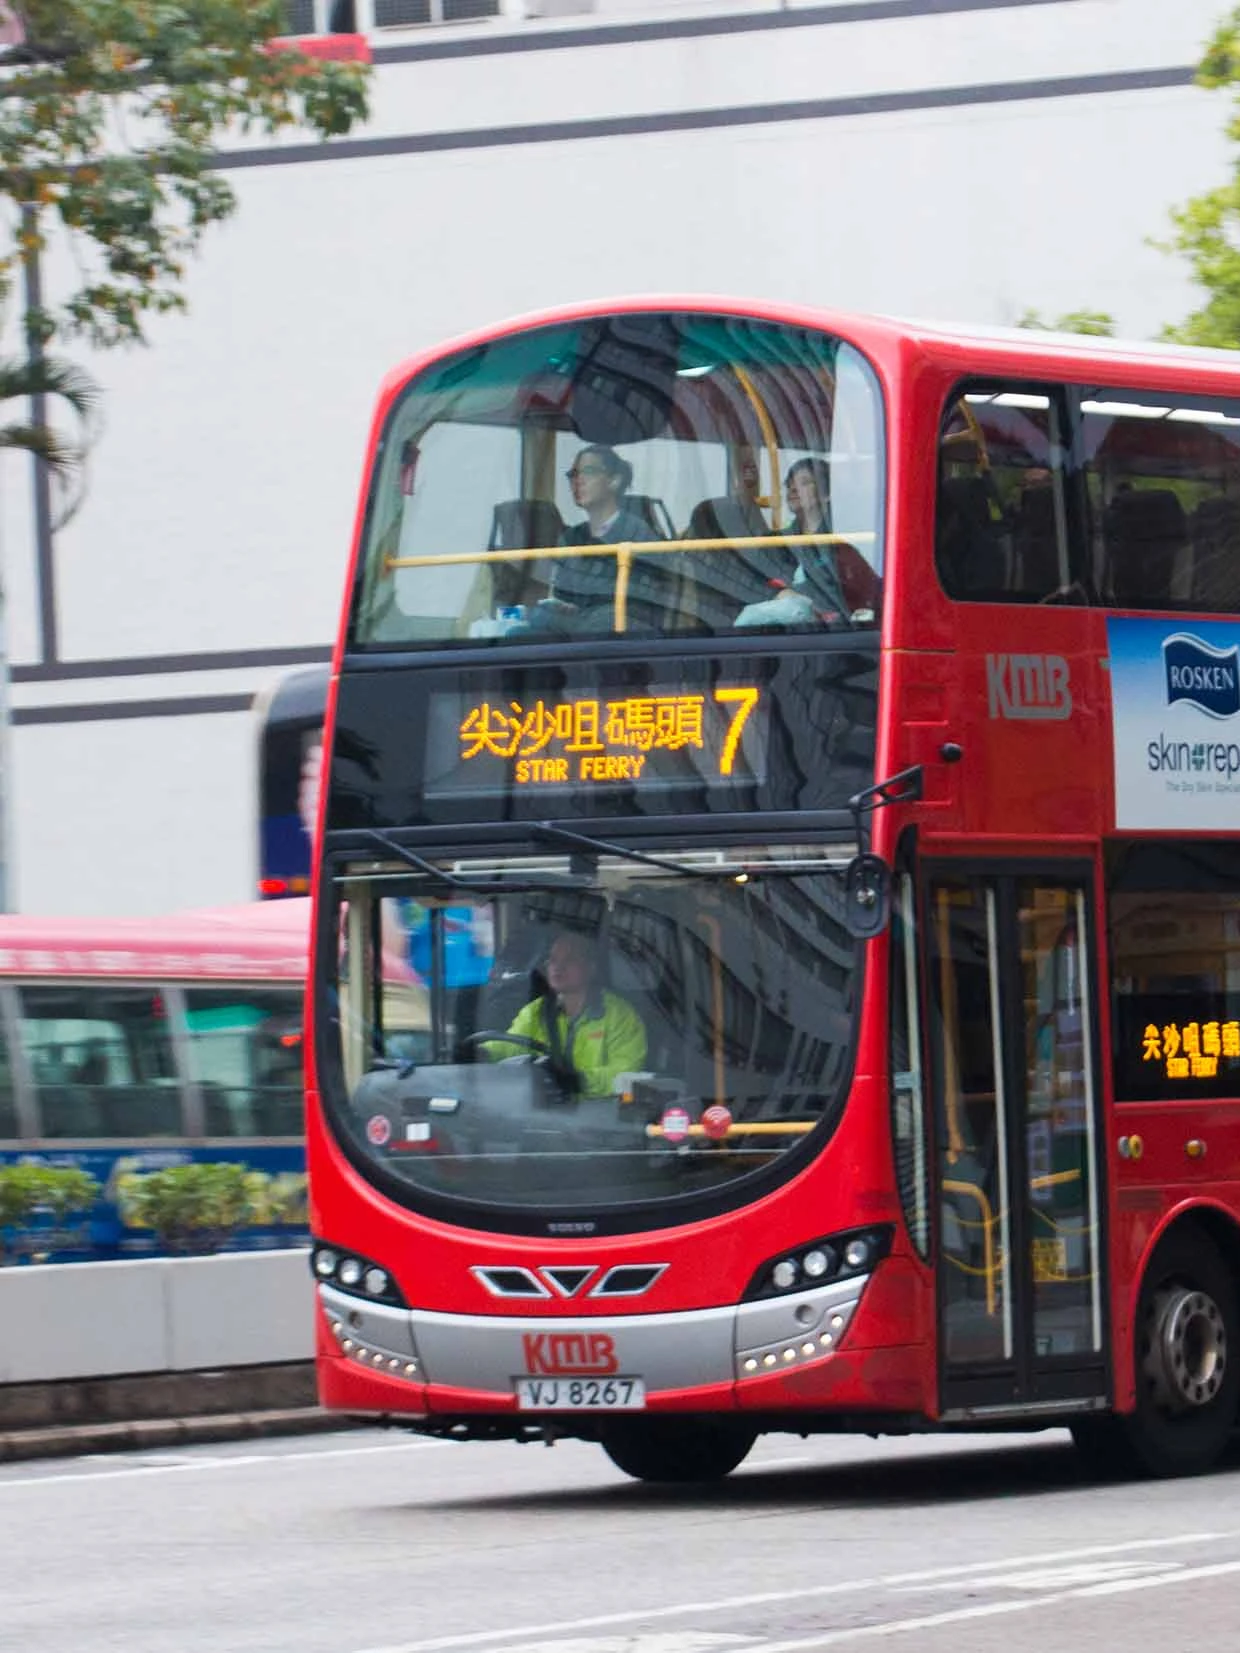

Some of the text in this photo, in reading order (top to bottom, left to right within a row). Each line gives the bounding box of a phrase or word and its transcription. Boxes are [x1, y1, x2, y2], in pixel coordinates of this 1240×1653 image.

[985, 653, 1073, 720] KMB
[1170, 664, 1235, 691] ROSKEN
[459, 687, 759, 776] 尖沙咀碼頭 7
[514, 755, 646, 783] STAR FERRY
[1147, 732, 1190, 772] skin
[521, 1331, 620, 1376] KMB
[528, 1381, 635, 1406] VJ 8267
